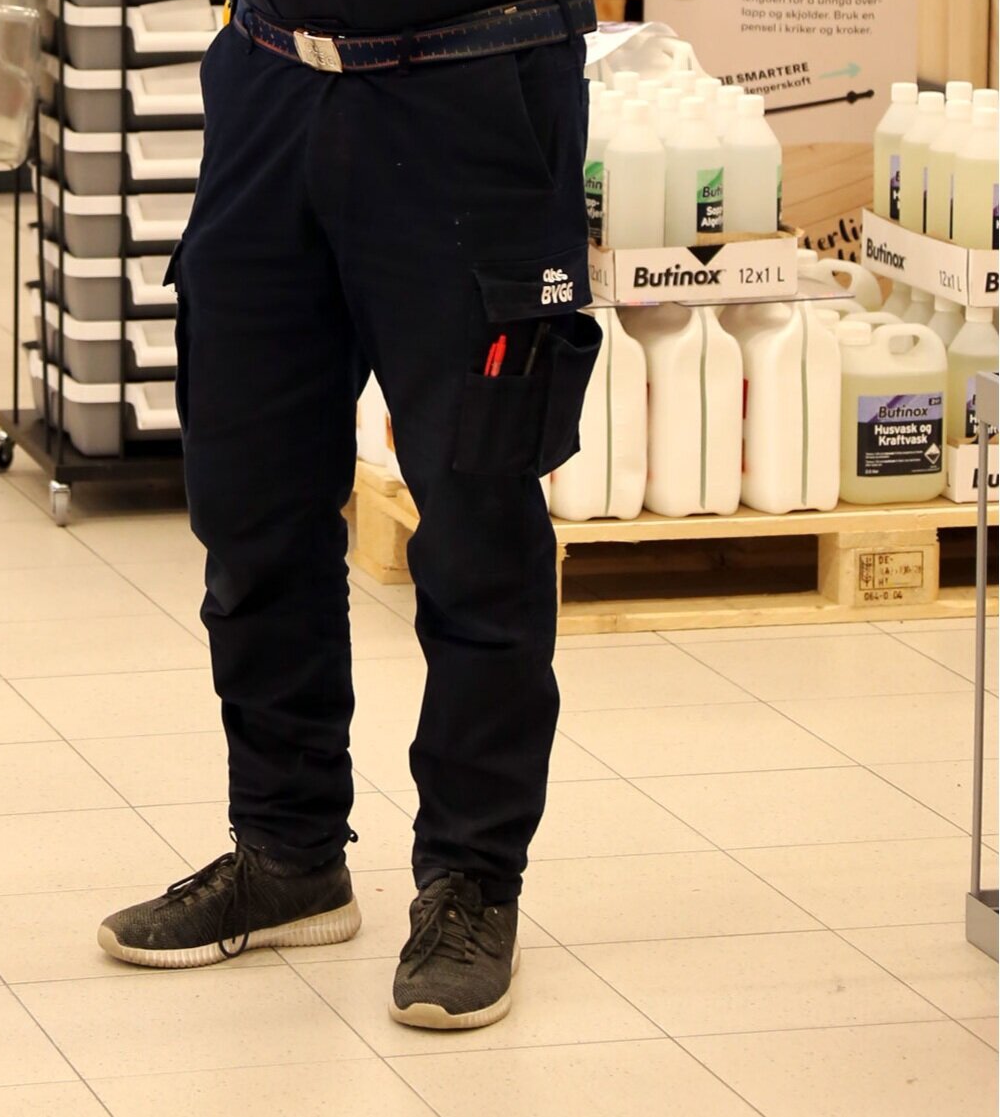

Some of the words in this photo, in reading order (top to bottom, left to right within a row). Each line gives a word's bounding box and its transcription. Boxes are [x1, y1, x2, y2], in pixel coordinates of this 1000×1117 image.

[768, 11, 783, 19] og
[834, 10, 858, 20] Bruk
[861, 13, 875, 21] en
[819, 26, 833, 36] og
[736, 62, 809, 84] SMARTERE
[866, 238, 905, 269] Butinox
[633, 264, 722, 288] Butinox
[739, 267, 769, 284] 12x1
[777, 267, 784, 282] L
[541, 282, 573, 305] BYGG
[879, 404, 928, 418] Butinox
[874, 423, 918, 435] Husvask
[919, 424, 932, 435] og
[878, 434, 928, 446] Kraftvask
